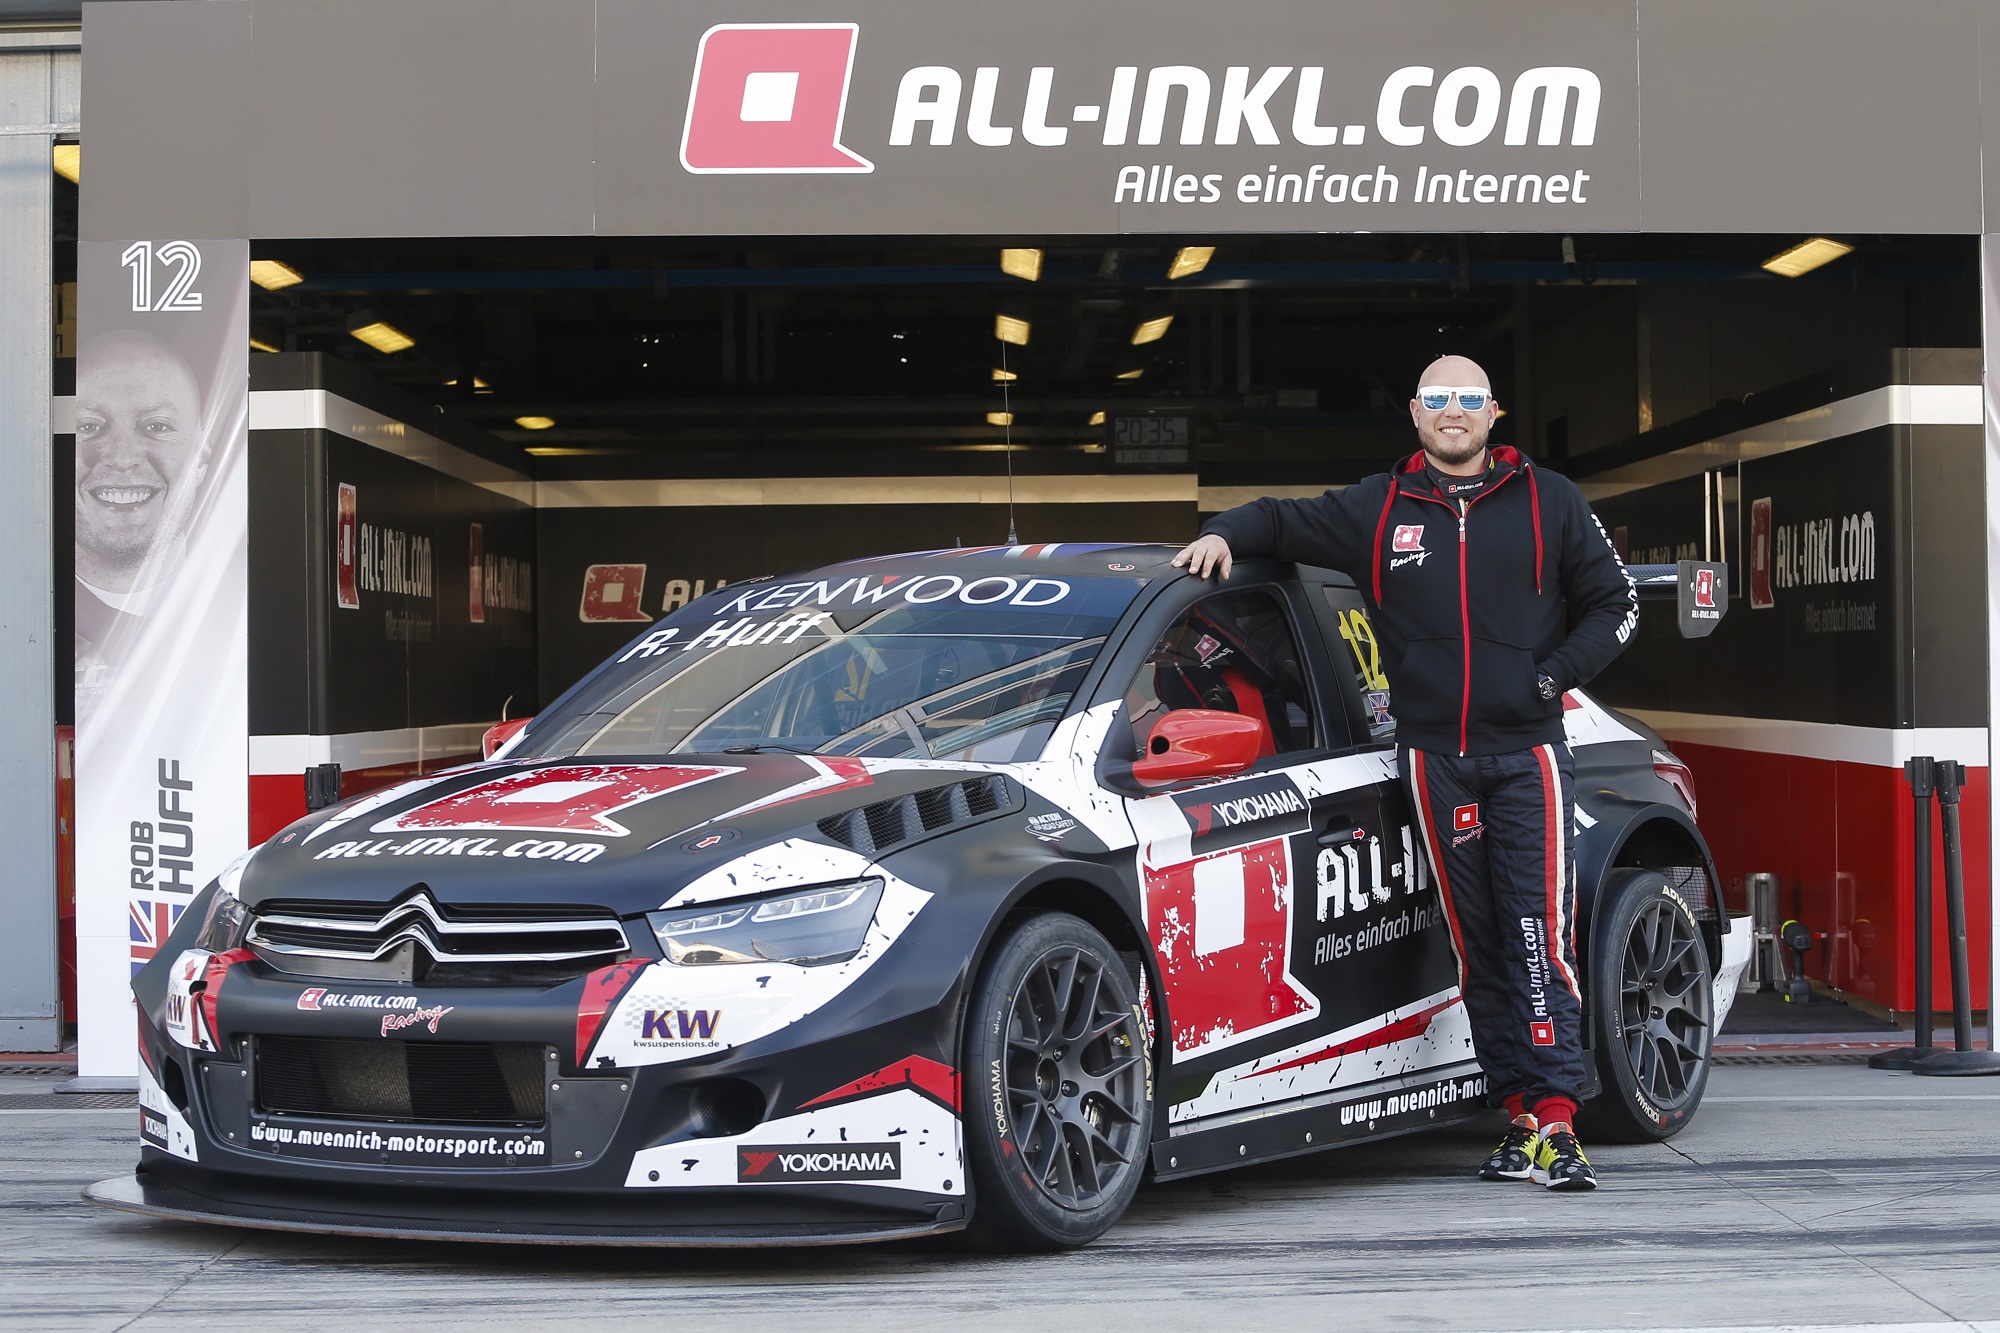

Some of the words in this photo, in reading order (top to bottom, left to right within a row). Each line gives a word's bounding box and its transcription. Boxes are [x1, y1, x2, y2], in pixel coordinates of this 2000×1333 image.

[887, 65, 1602, 147] ALL-INKL.COM
[1113, 165, 1223, 206] Alles
[1236, 165, 1401, 206] einfach
[1414, 167, 1590, 205] Internet
[121, 240, 203, 313] 12
[1116, 418, 1175, 443] 20:35
[1390, 551, 1432, 571] Racing
[713, 575, 1071, 616] KENWOOD
[616, 628, 680, 664] R.
[681, 612, 833, 653] Huff
[1338, 609, 1390, 690] 12
[158, 758, 193, 895] HUFF
[1037, 812, 1063, 824] ACTION
[1212, 788, 1305, 828] YOKOHAMA
[130, 820, 154, 891] ROB
[312, 837, 608, 863] ALL-INKL.COM
[1662, 884, 1696, 929] ADVAN
[1314, 932, 1353, 966] Alles
[1356, 910, 1409, 952] einfach
[1520, 917, 1548, 1017] ALL-INKL.COM
[322, 993, 418, 1010] ALL-INKL.COM
[380, 1004, 454, 1038] Racing
[633, 1039, 720, 1049] kwsuspensions.de
[641, 1009, 724, 1040] KW
[1131, 1003, 1153, 1102] ADVAN
[991, 1058, 1008, 1139] YOKOHAMA
[1634, 1086, 1660, 1124] YOKOHAMA
[250, 1124, 545, 1158] www.muennich-motorsport.com
[777, 1152, 896, 1173] YOKOHAMA
